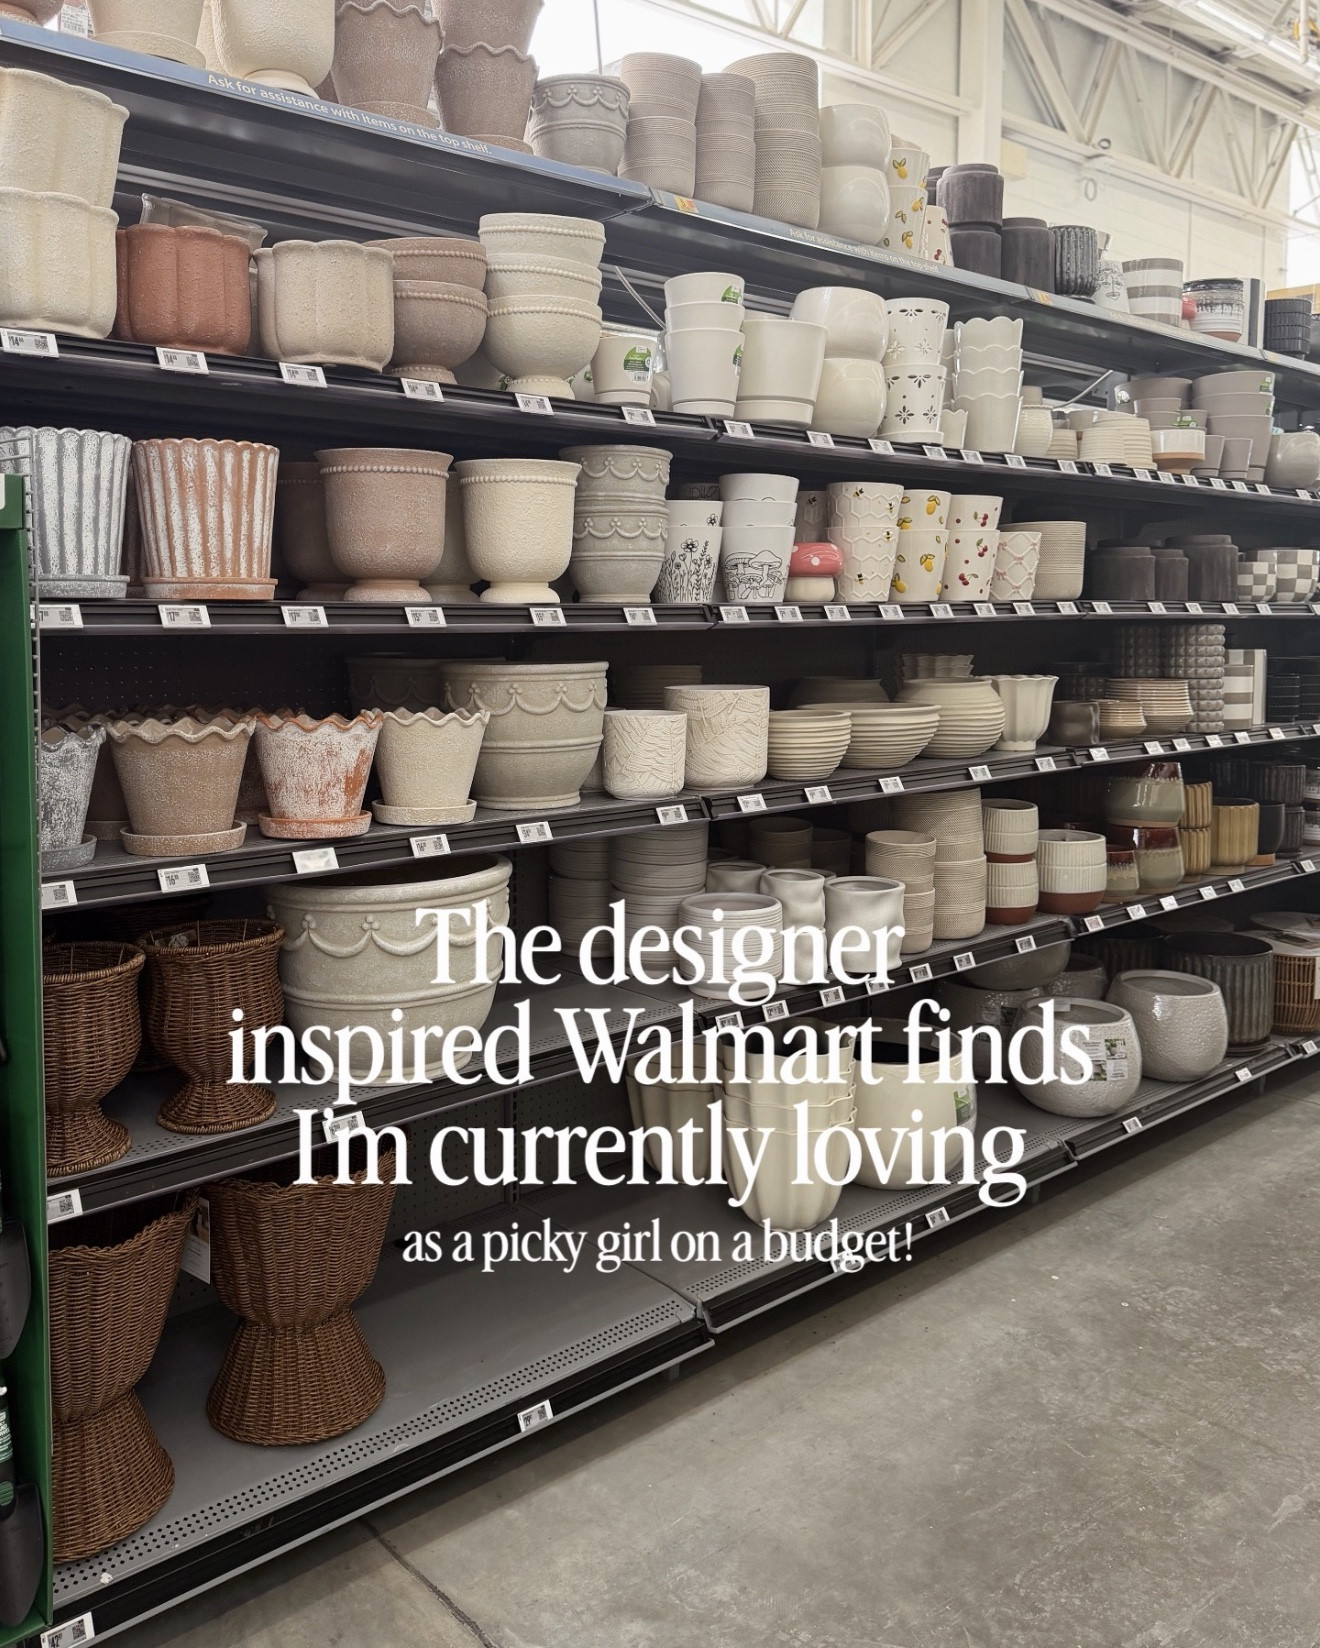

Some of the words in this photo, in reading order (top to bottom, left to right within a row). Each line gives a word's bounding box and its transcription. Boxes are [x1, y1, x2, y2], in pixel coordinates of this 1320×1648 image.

[208, 74, 233, 88] Ask
[236, 82, 256, 95] for
[260, 89, 328, 113] assistance
[331, 107, 360, 120] with
[362, 113, 397, 131] items
[399, 126, 416, 136] on
[417, 128, 438, 141] the
[439, 134, 460, 148] top
[462, 140, 492, 155] shelf.
